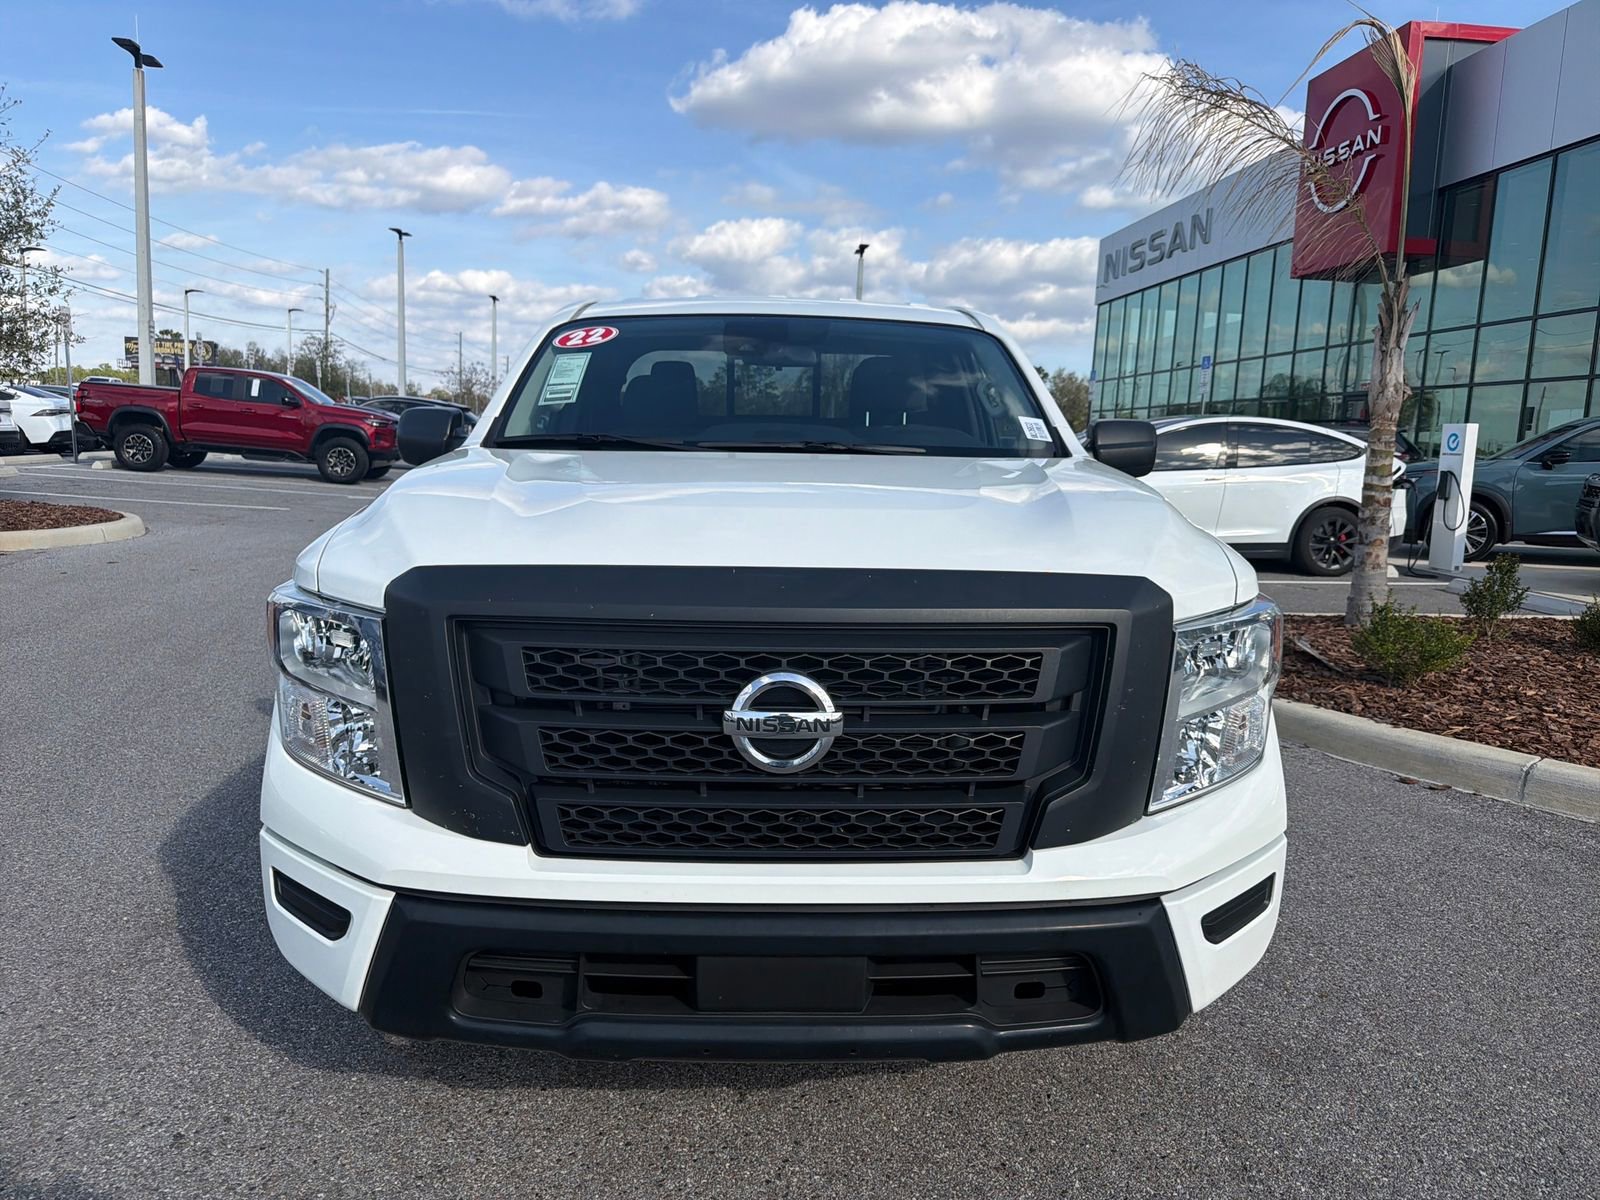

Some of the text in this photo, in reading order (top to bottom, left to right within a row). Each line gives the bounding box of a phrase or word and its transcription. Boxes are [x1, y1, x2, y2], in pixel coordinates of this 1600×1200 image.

[1103, 207, 1213, 284] NISSAN
[566, 327, 606, 346] 22
[736, 717, 831, 733] NISSAN
